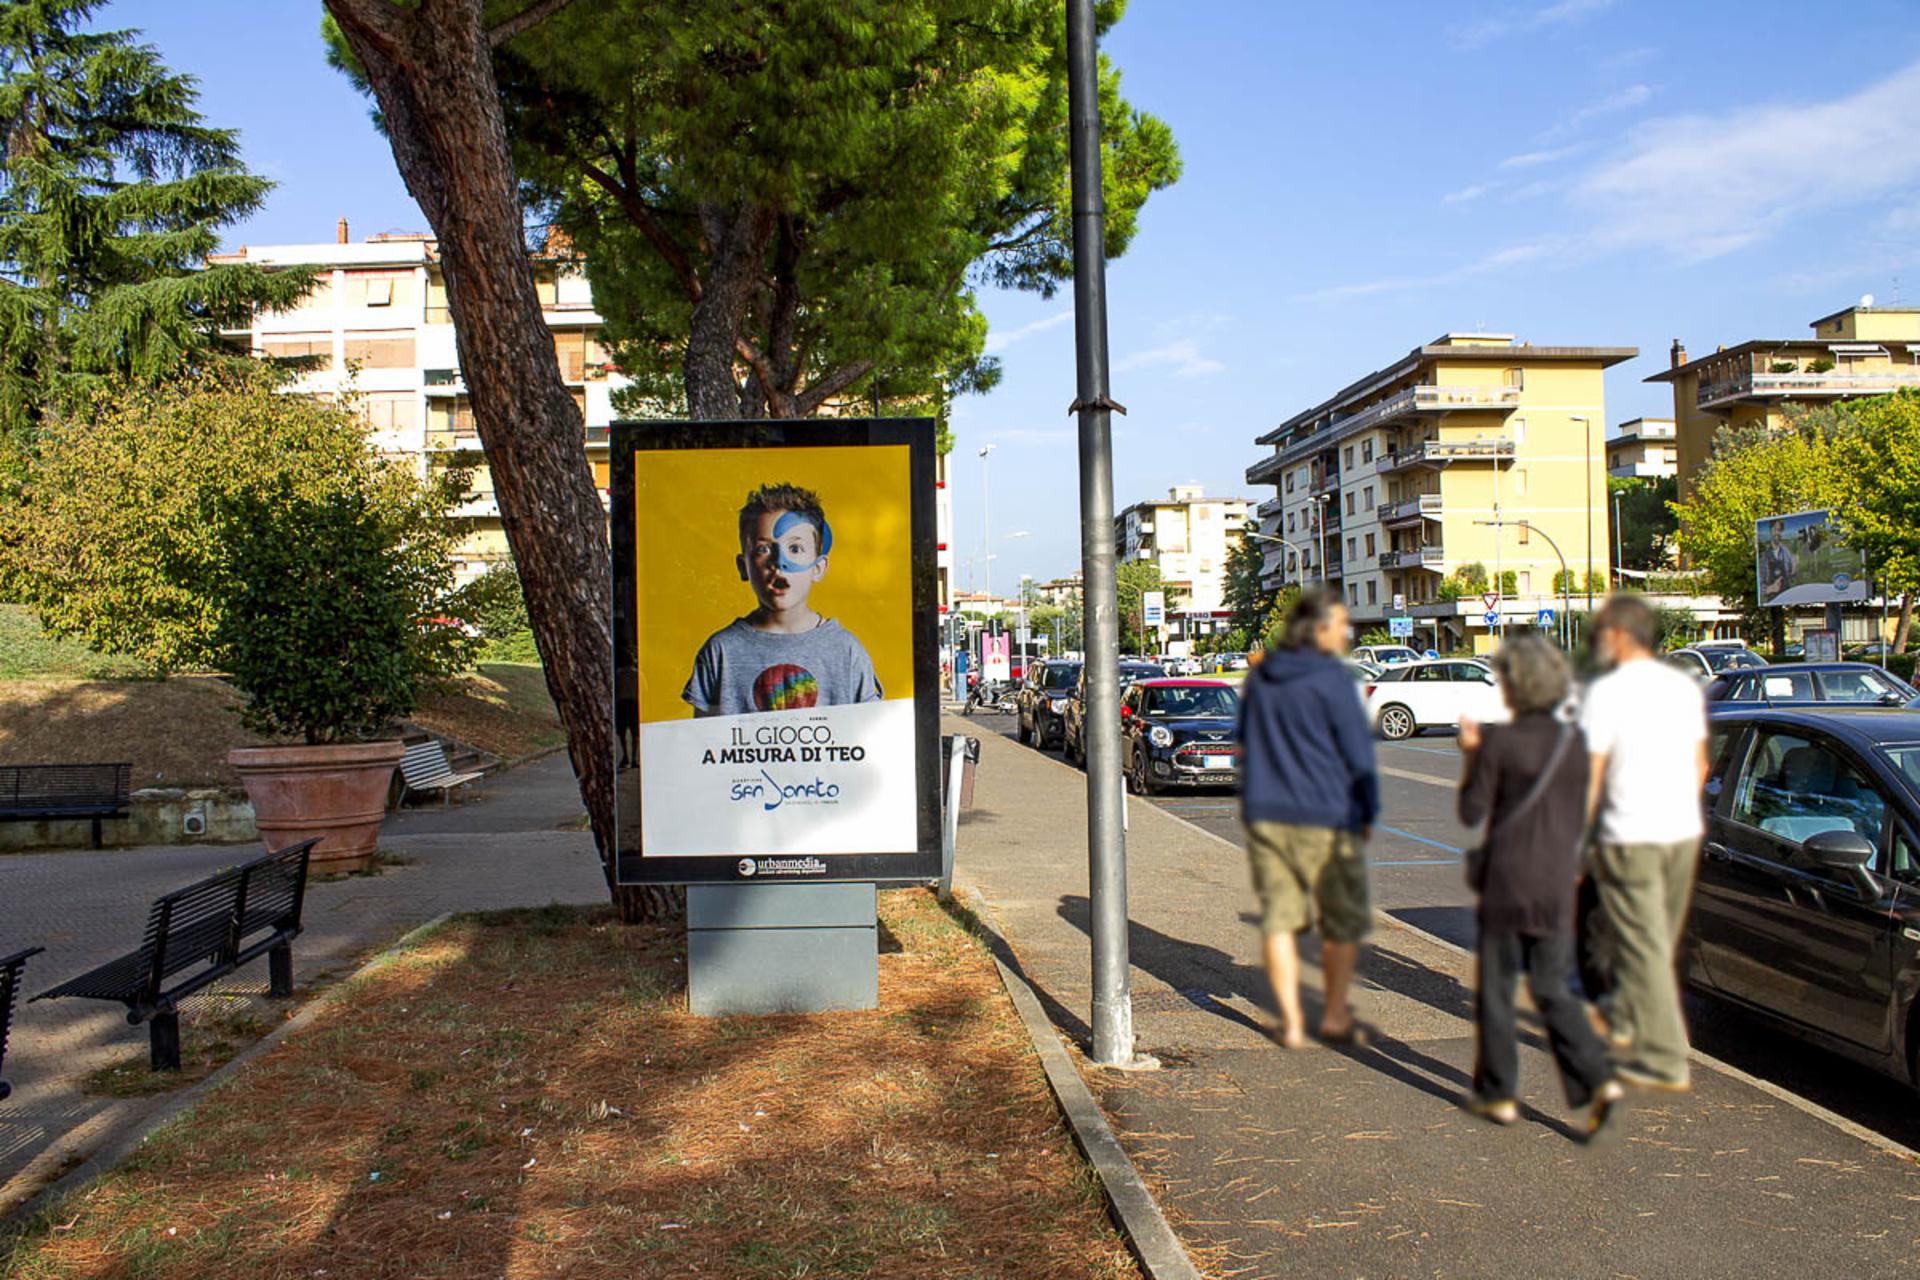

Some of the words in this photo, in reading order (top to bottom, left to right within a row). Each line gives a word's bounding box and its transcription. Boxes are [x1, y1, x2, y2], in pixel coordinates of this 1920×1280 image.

[731, 727, 751, 746] IL
[756, 725, 835, 745] GIOCO,
[702, 749, 716, 764] A
[720, 747, 796, 764] MISURA
[801, 747, 822, 762] DI
[825, 746, 866, 762] TEO
